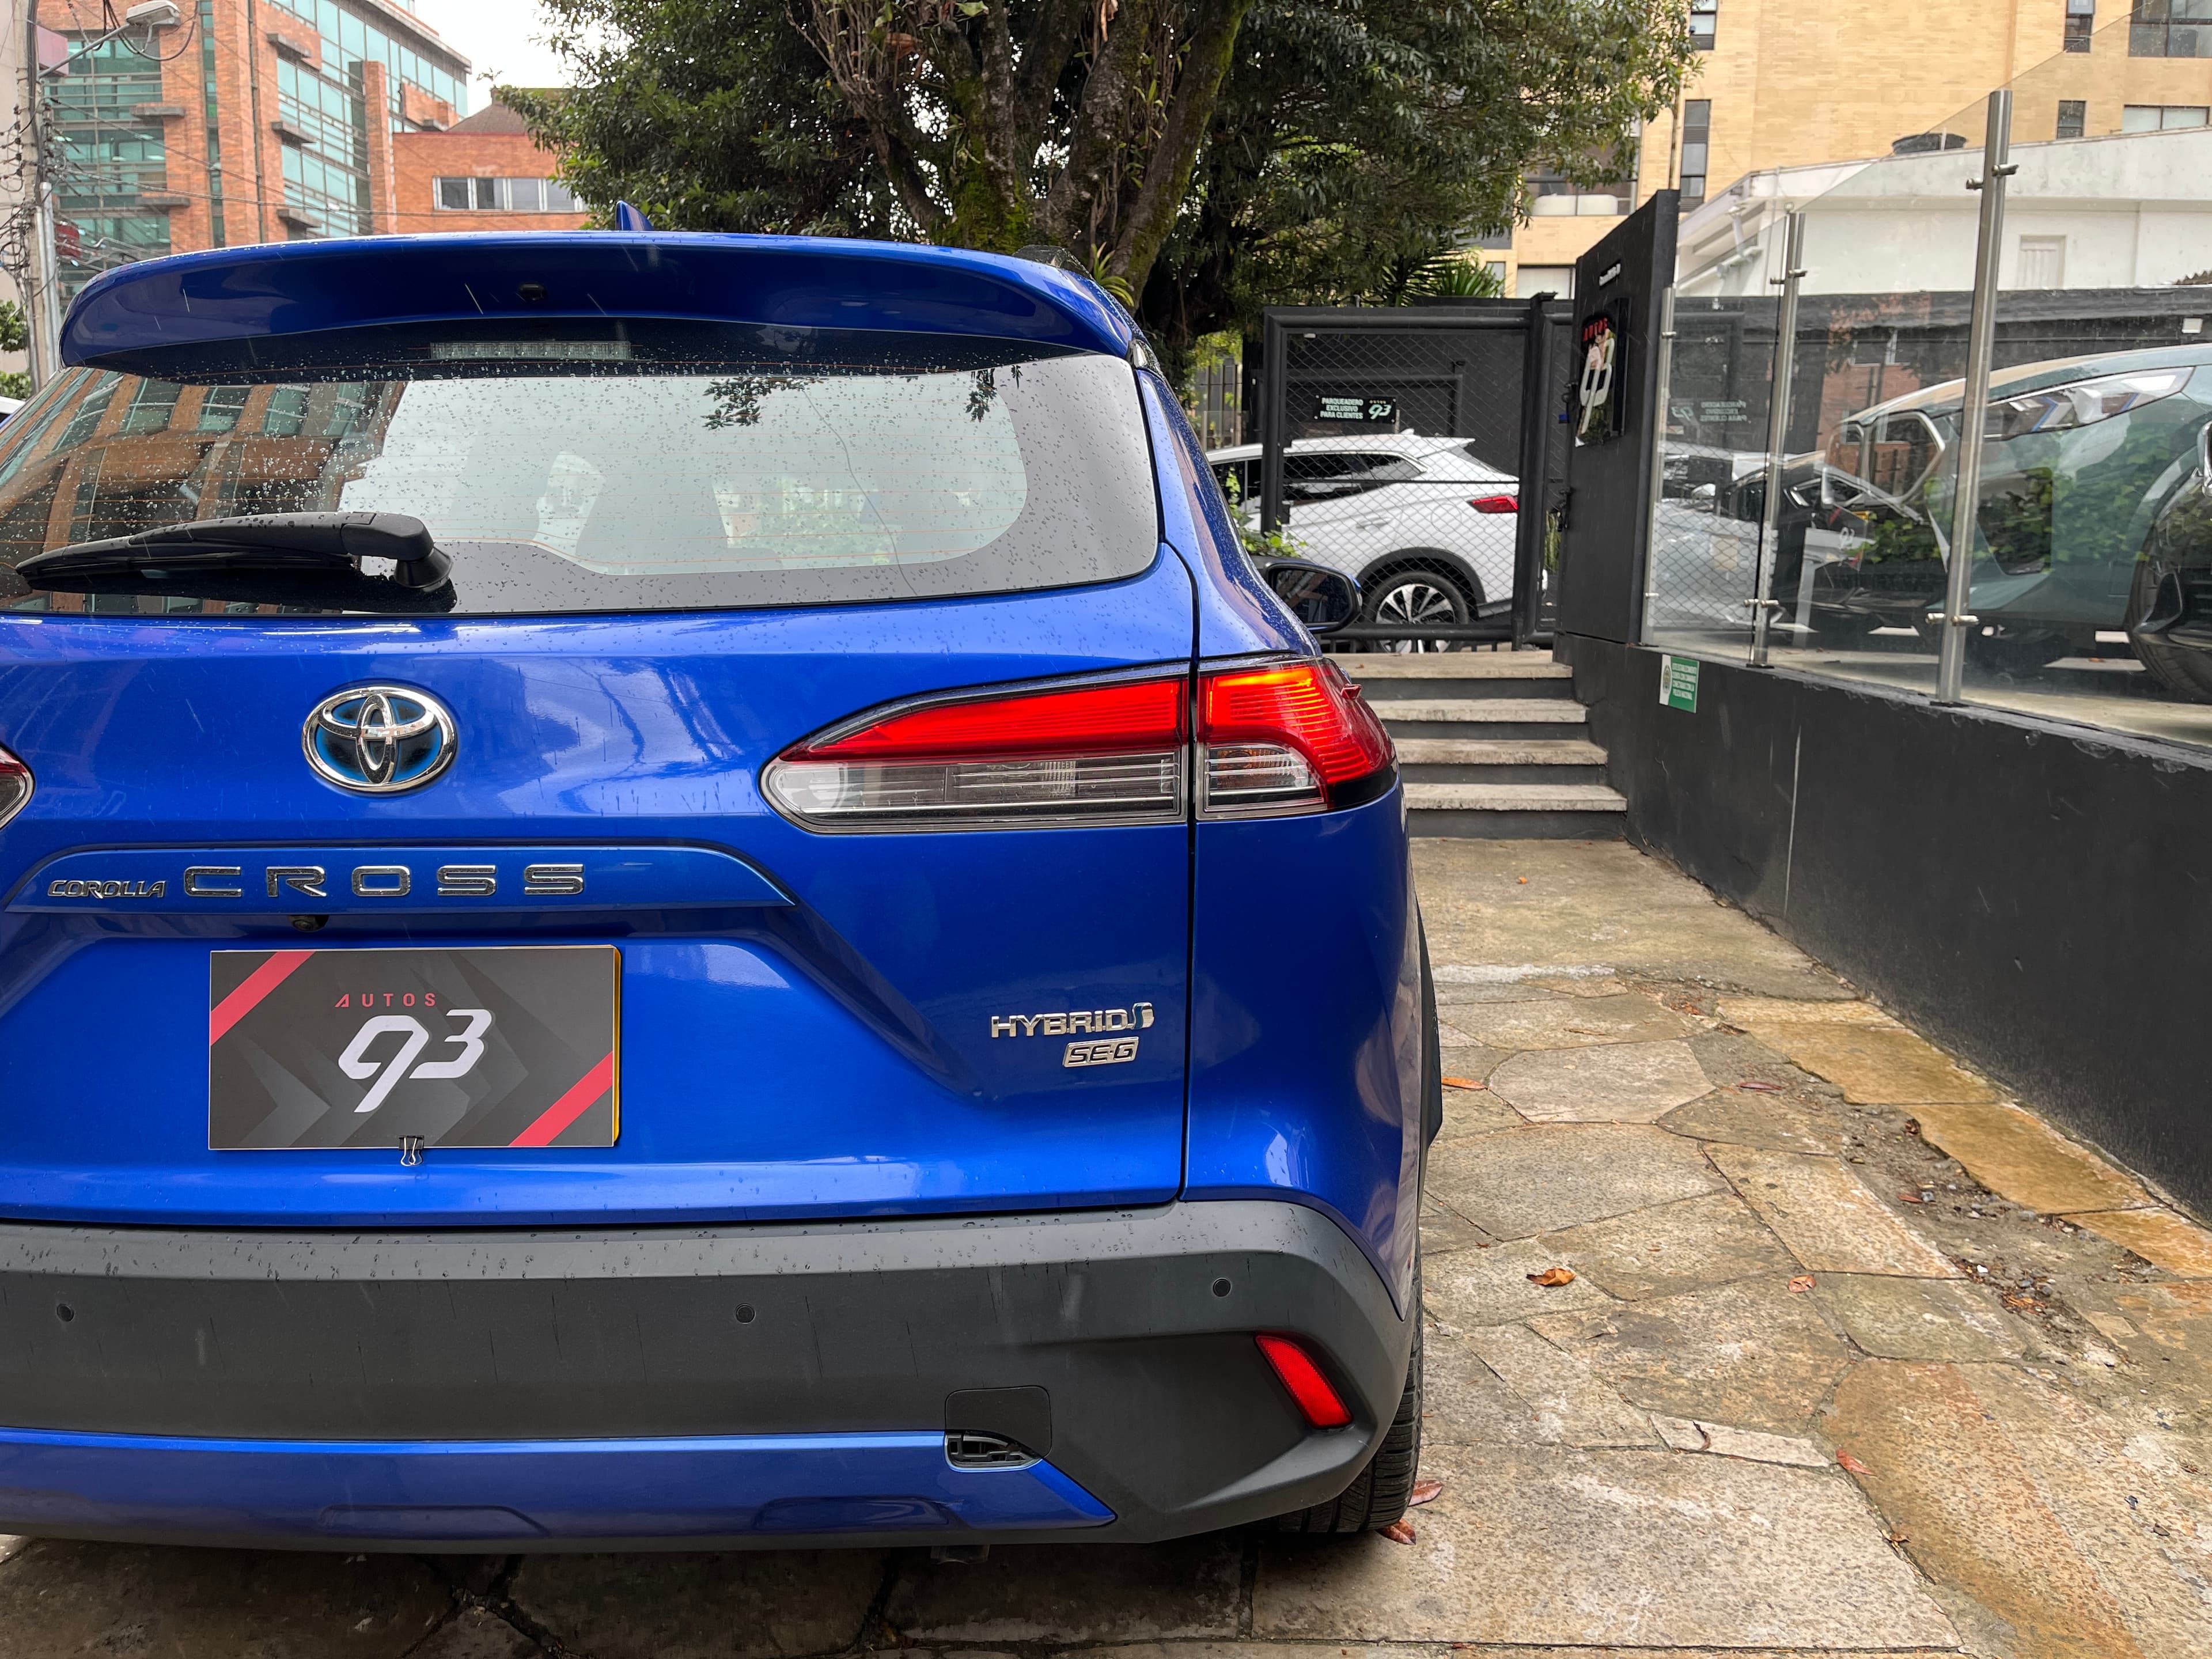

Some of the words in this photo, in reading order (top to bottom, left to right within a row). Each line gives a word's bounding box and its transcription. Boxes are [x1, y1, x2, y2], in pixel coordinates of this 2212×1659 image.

[1321, 397, 1363, 406] PARQUEADERO
[1368, 404, 1392, 419] 93
[47, 880, 166, 899] COROLLA
[184, 863, 585, 897] CROSS
[334, 993, 436, 1007] AUTOS
[991, 1009, 1128, 1037] HYBRID
[338, 1009, 492, 1113] 93
